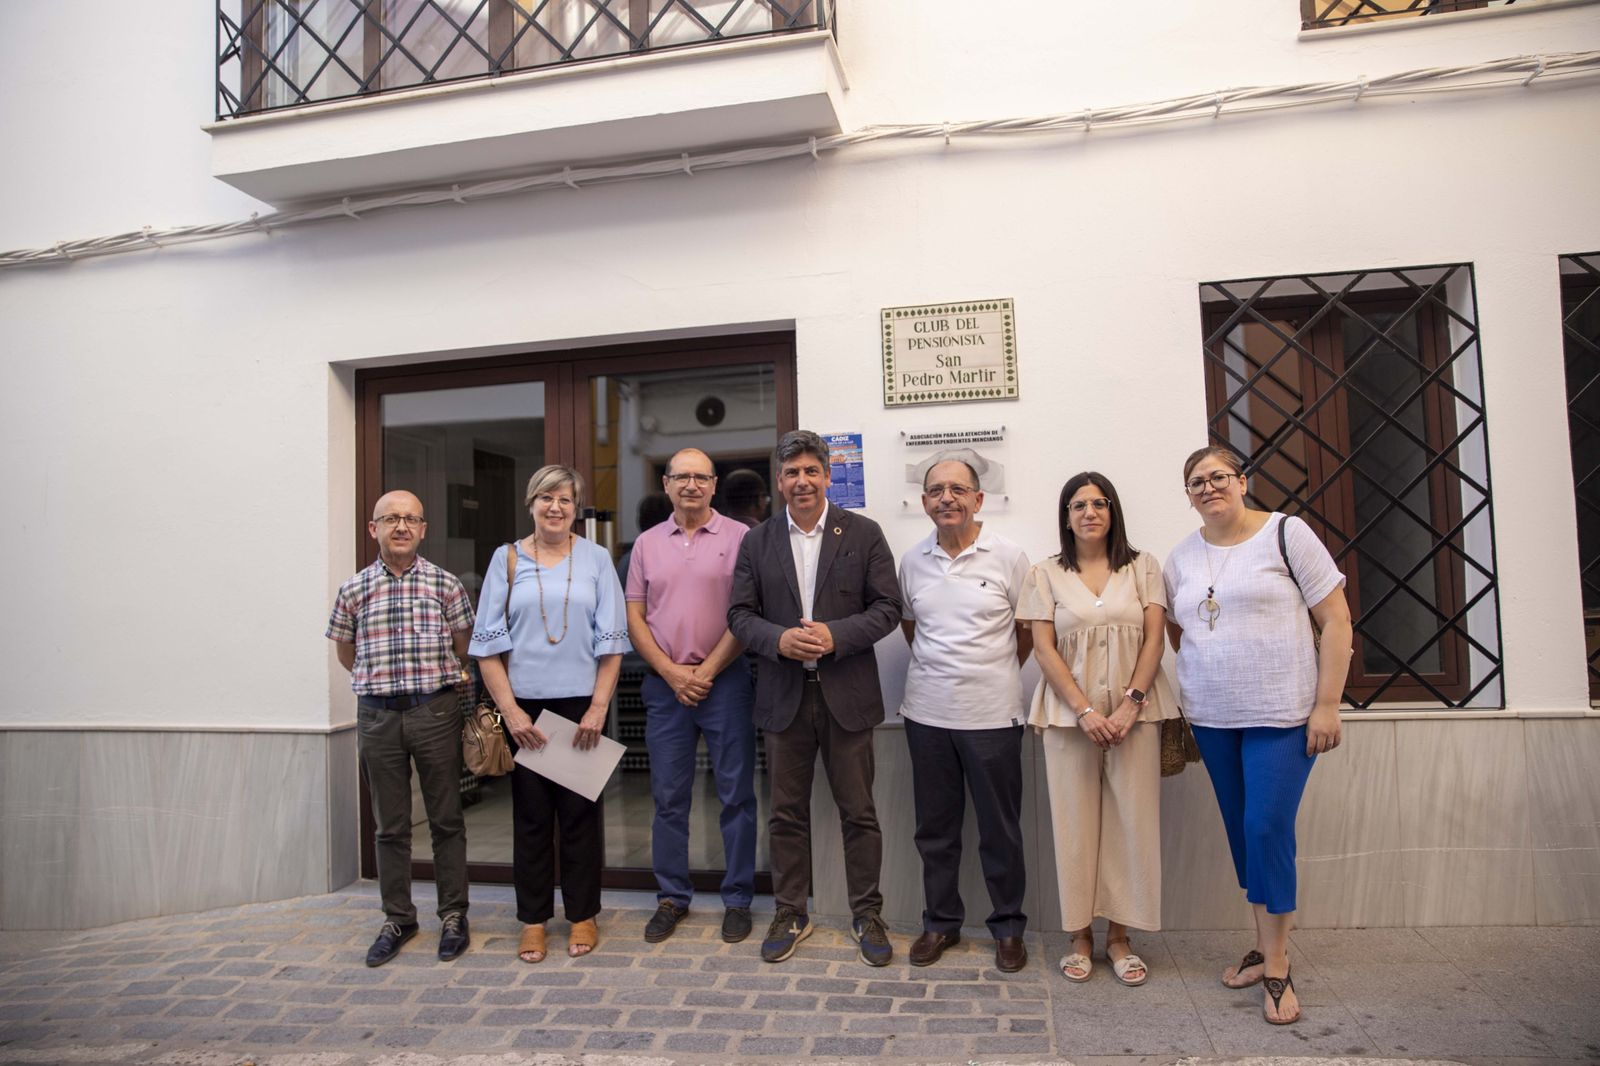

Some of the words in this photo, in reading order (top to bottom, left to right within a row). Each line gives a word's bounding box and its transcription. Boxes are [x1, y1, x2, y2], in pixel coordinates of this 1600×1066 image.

[914, 320, 950, 334] CLUB
[956, 318, 980, 330] DEL
[908, 334, 985, 350] PENSIONISTA
[936, 354, 962, 368] San
[902, 372, 944, 388] Pedro
[950, 368, 996, 384] Martir
